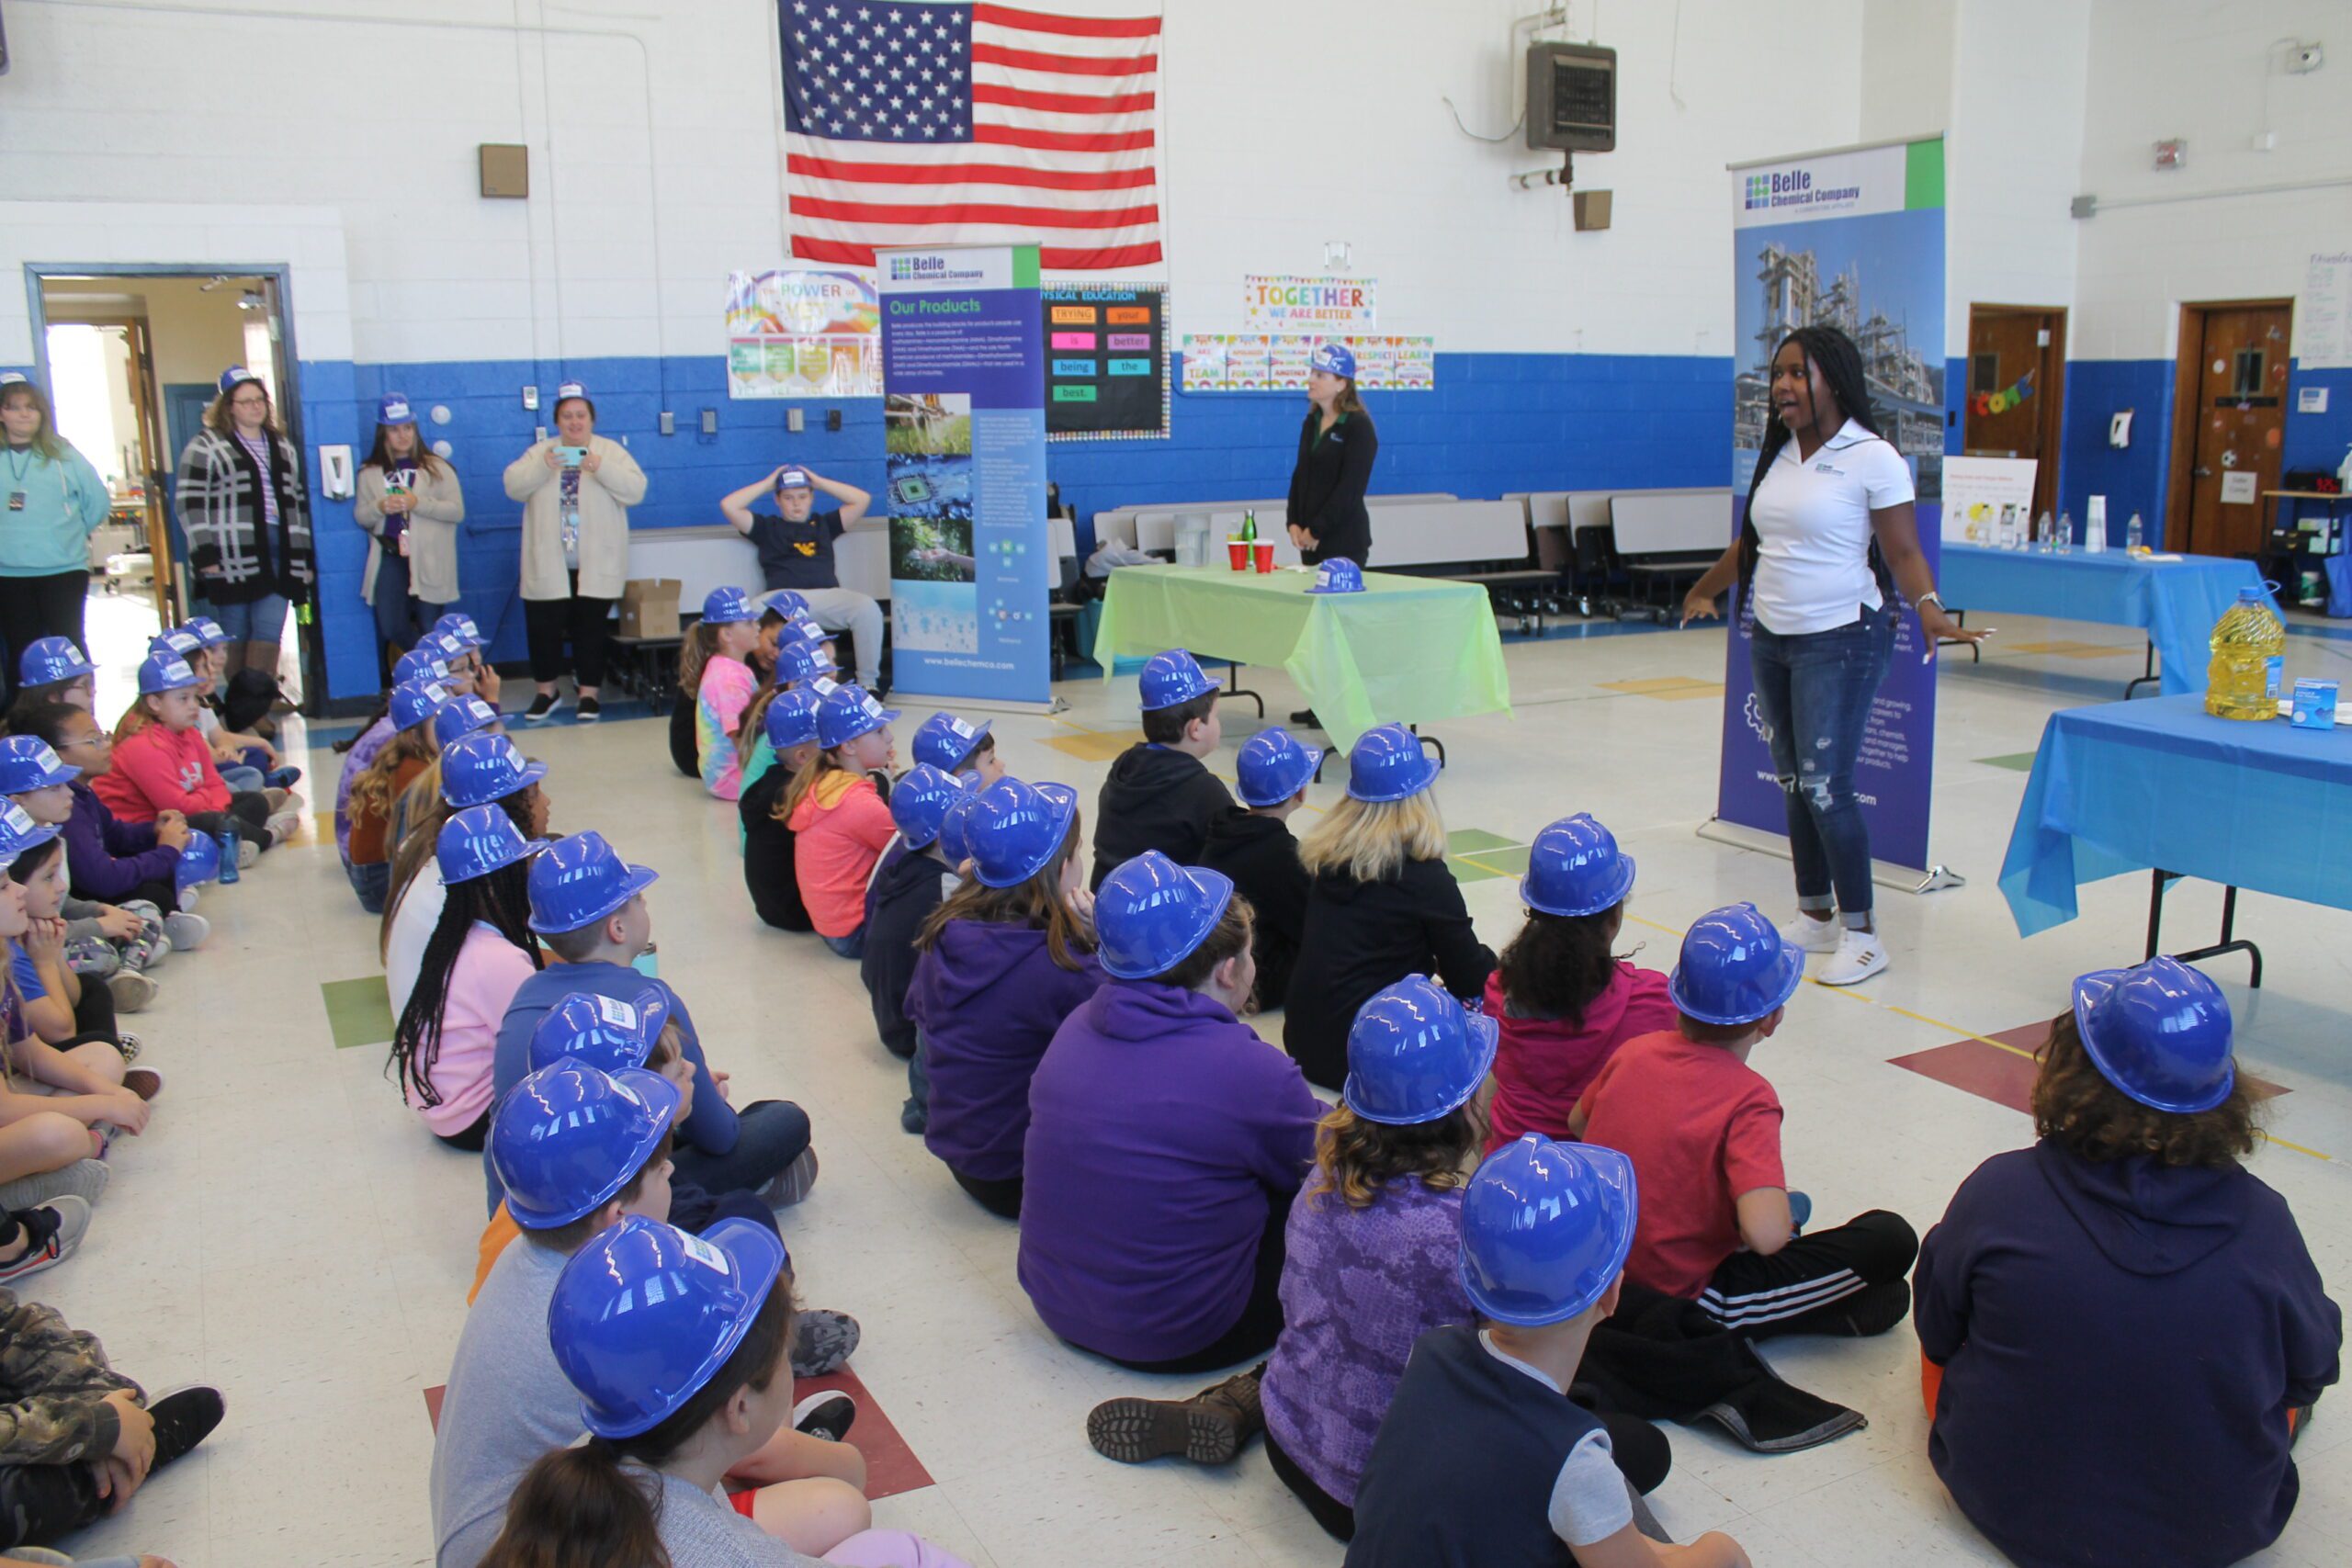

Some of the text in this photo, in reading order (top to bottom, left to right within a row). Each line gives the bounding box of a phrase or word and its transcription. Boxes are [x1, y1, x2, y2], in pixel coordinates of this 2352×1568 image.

[1770, 170, 1811, 193] Belle
[1770, 186, 1860, 208] Chemical Company
[911, 256, 944, 271] Belle
[911, 270, 984, 280] Chemical Company
[781, 284, 842, 298] POWER
[1081, 290, 1137, 301] EDUCATION
[1256, 285, 1364, 308] TOGETHER
[889, 298, 981, 315] Our Products
[1055, 309, 1140, 320] TRYING your
[1269, 308, 1352, 320] WE ARE BETTER
[1070, 335, 1145, 346] is better
[1356, 351, 1392, 360] RESPECT
[1397, 350, 1430, 360] LEARN
[1060, 360, 1138, 373] being the
[1189, 368, 1220, 378] TEAM
[804, 385, 824, 396] YET
[1062, 388, 1087, 398] best.
